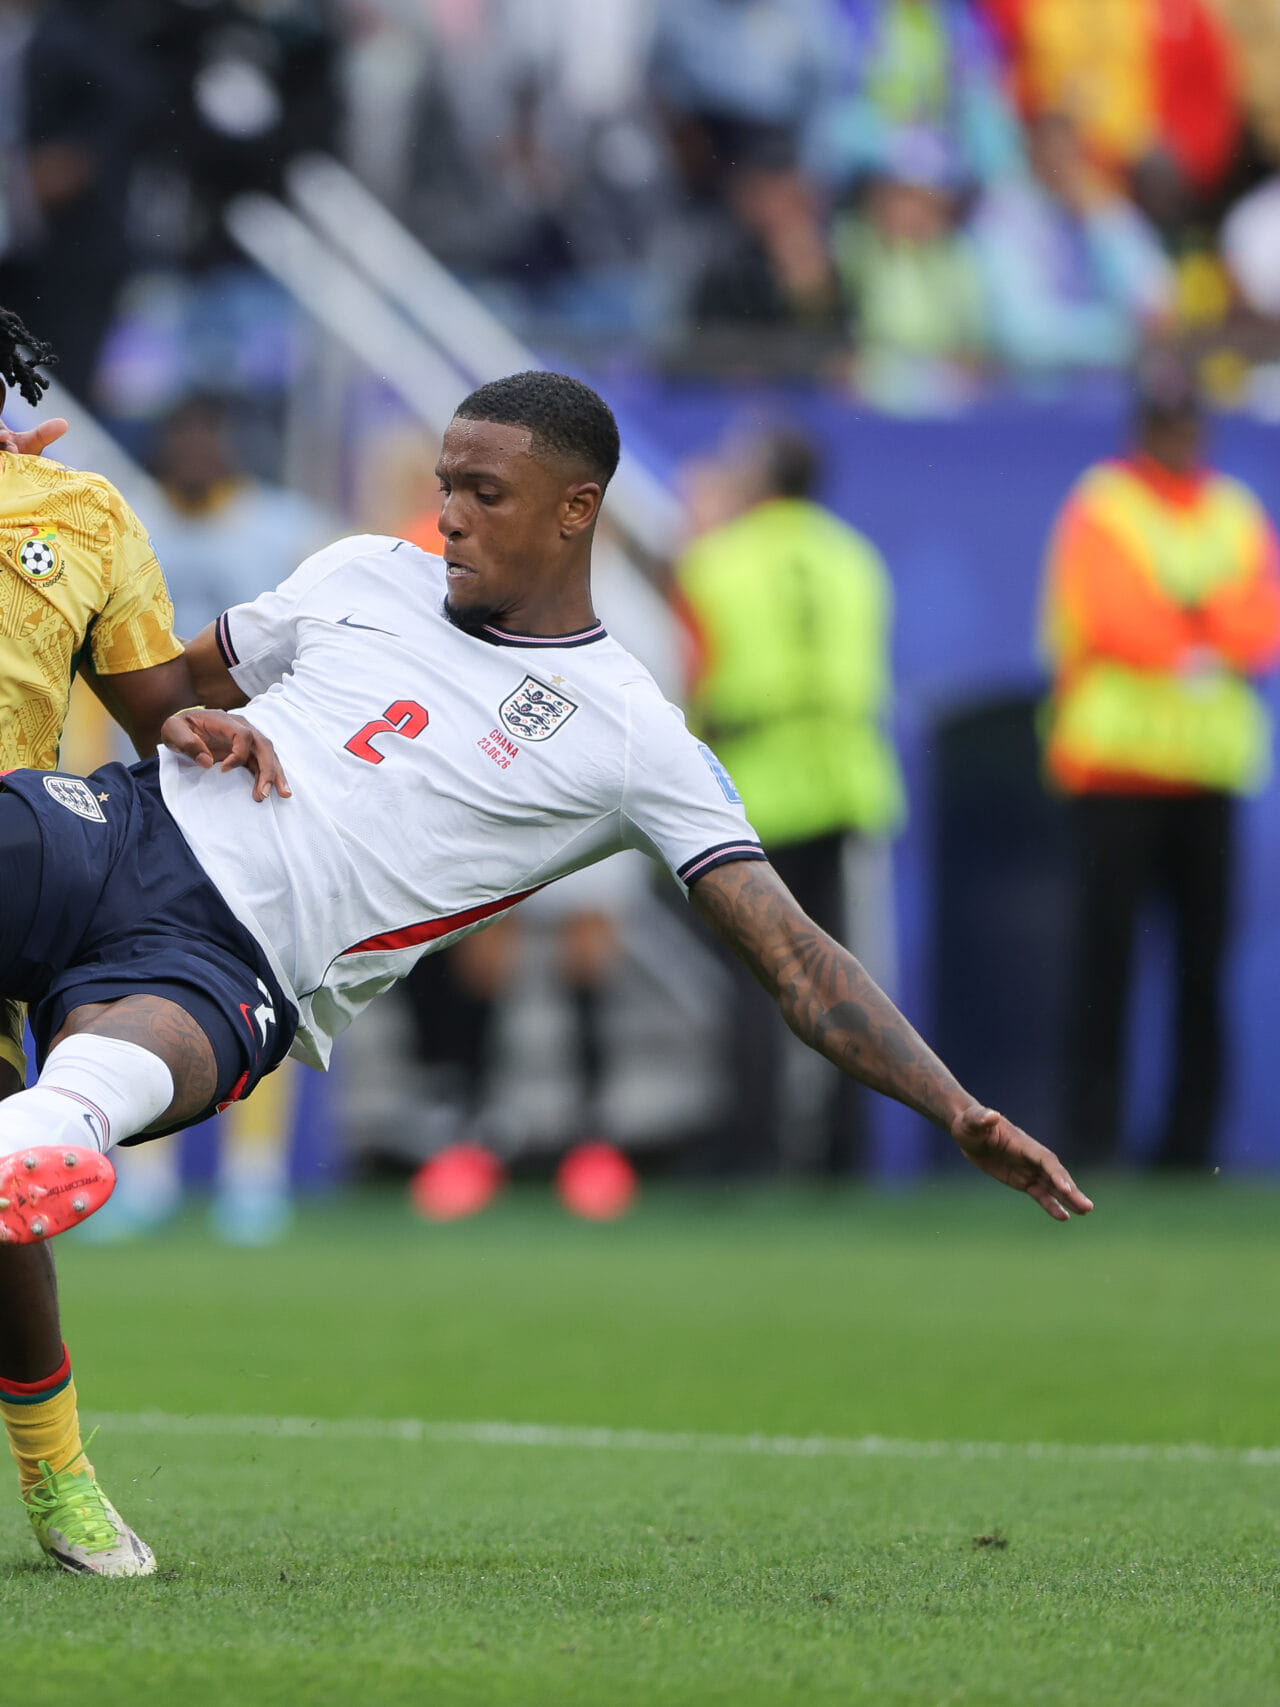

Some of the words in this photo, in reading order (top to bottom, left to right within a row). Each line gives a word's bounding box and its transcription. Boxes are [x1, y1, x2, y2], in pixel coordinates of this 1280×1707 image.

[344, 699, 429, 765] 2
[489, 728, 519, 759] GHANA
[476, 737, 511, 769] 23.06.26
